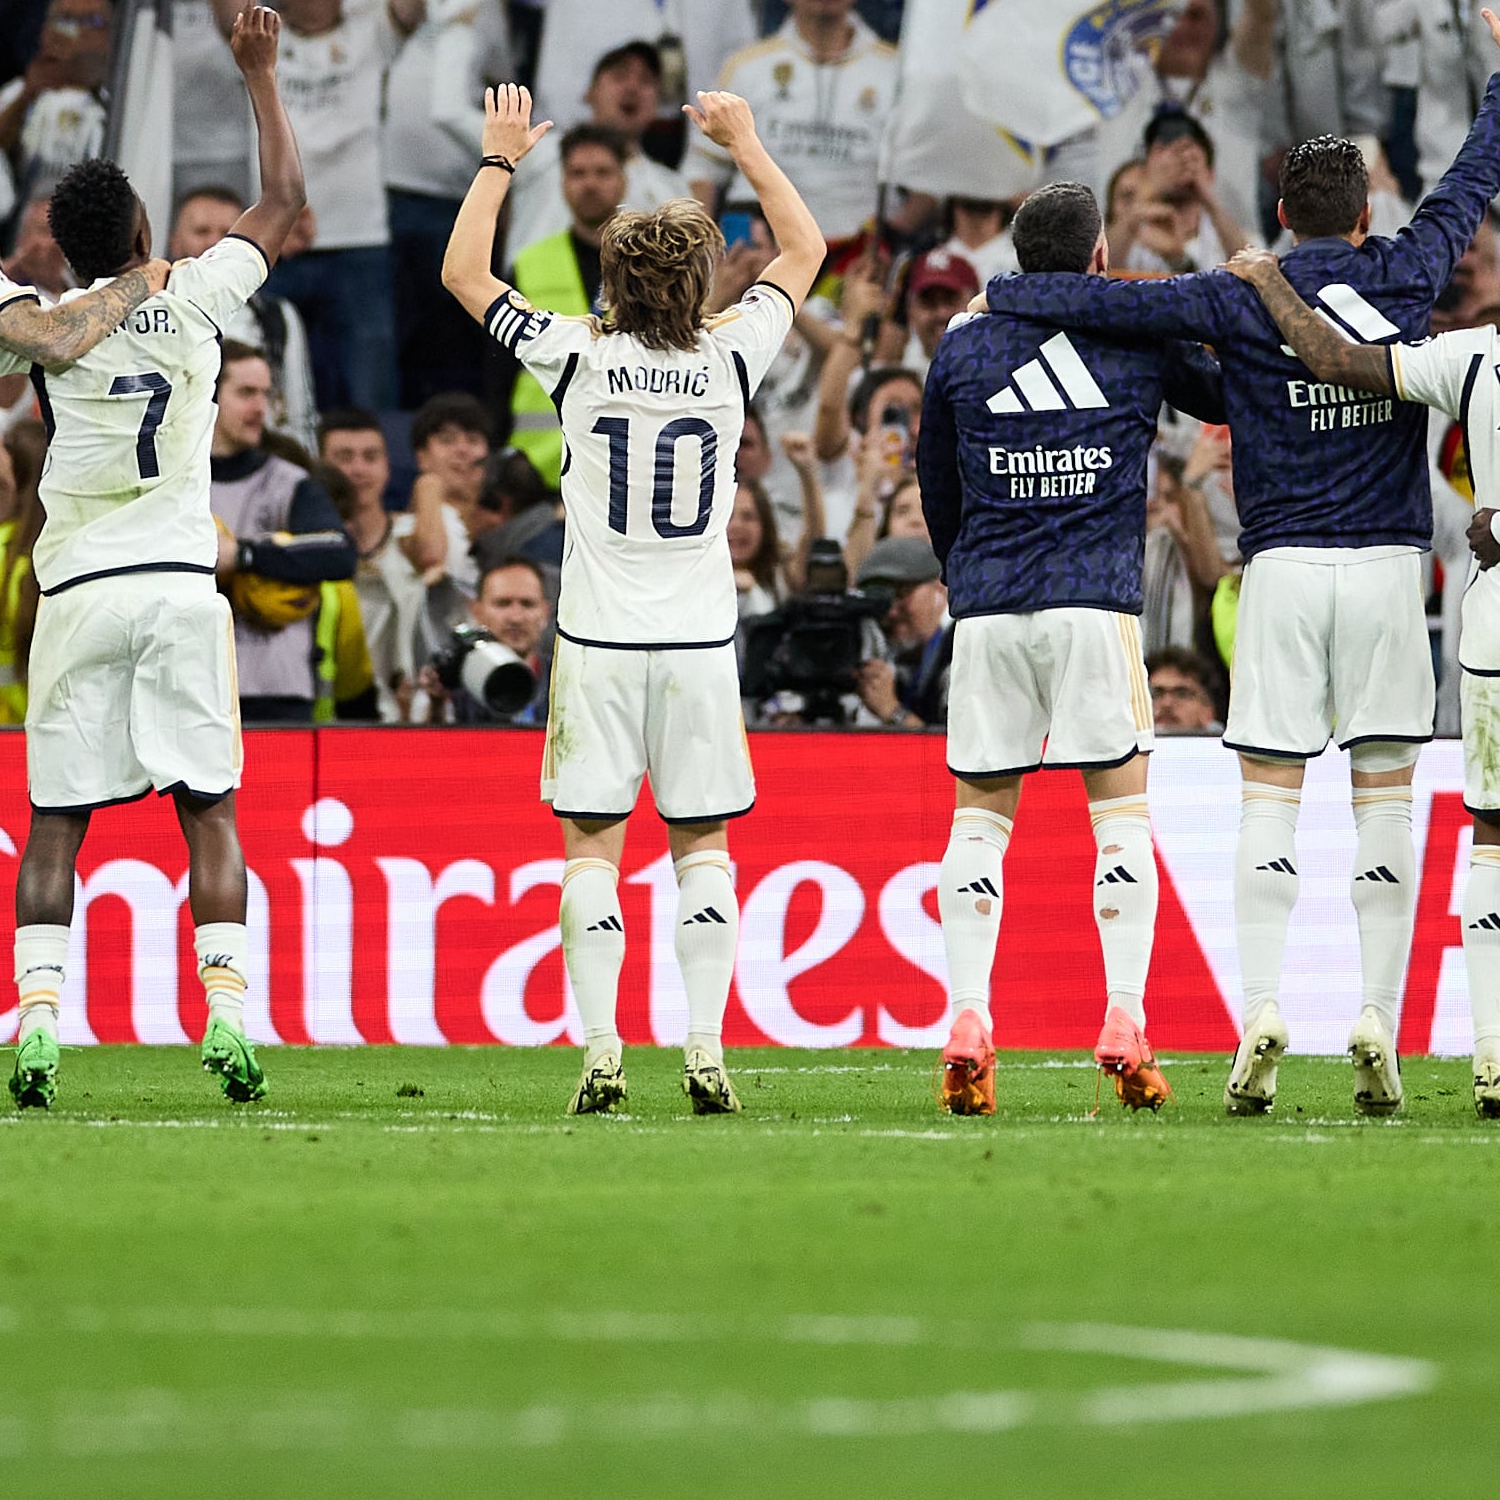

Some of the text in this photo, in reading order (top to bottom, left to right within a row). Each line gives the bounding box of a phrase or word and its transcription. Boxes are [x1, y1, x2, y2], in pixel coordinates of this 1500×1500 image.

[135, 309, 177, 334] JR.
[607, 366, 709, 397] MODRIĆ
[108, 372, 173, 480] 7
[1311, 399, 1393, 431] FLY BETTER
[988, 443, 1113, 476] Emirates
[590, 416, 718, 539] 10
[1010, 472, 1097, 499] FLY BETTER
